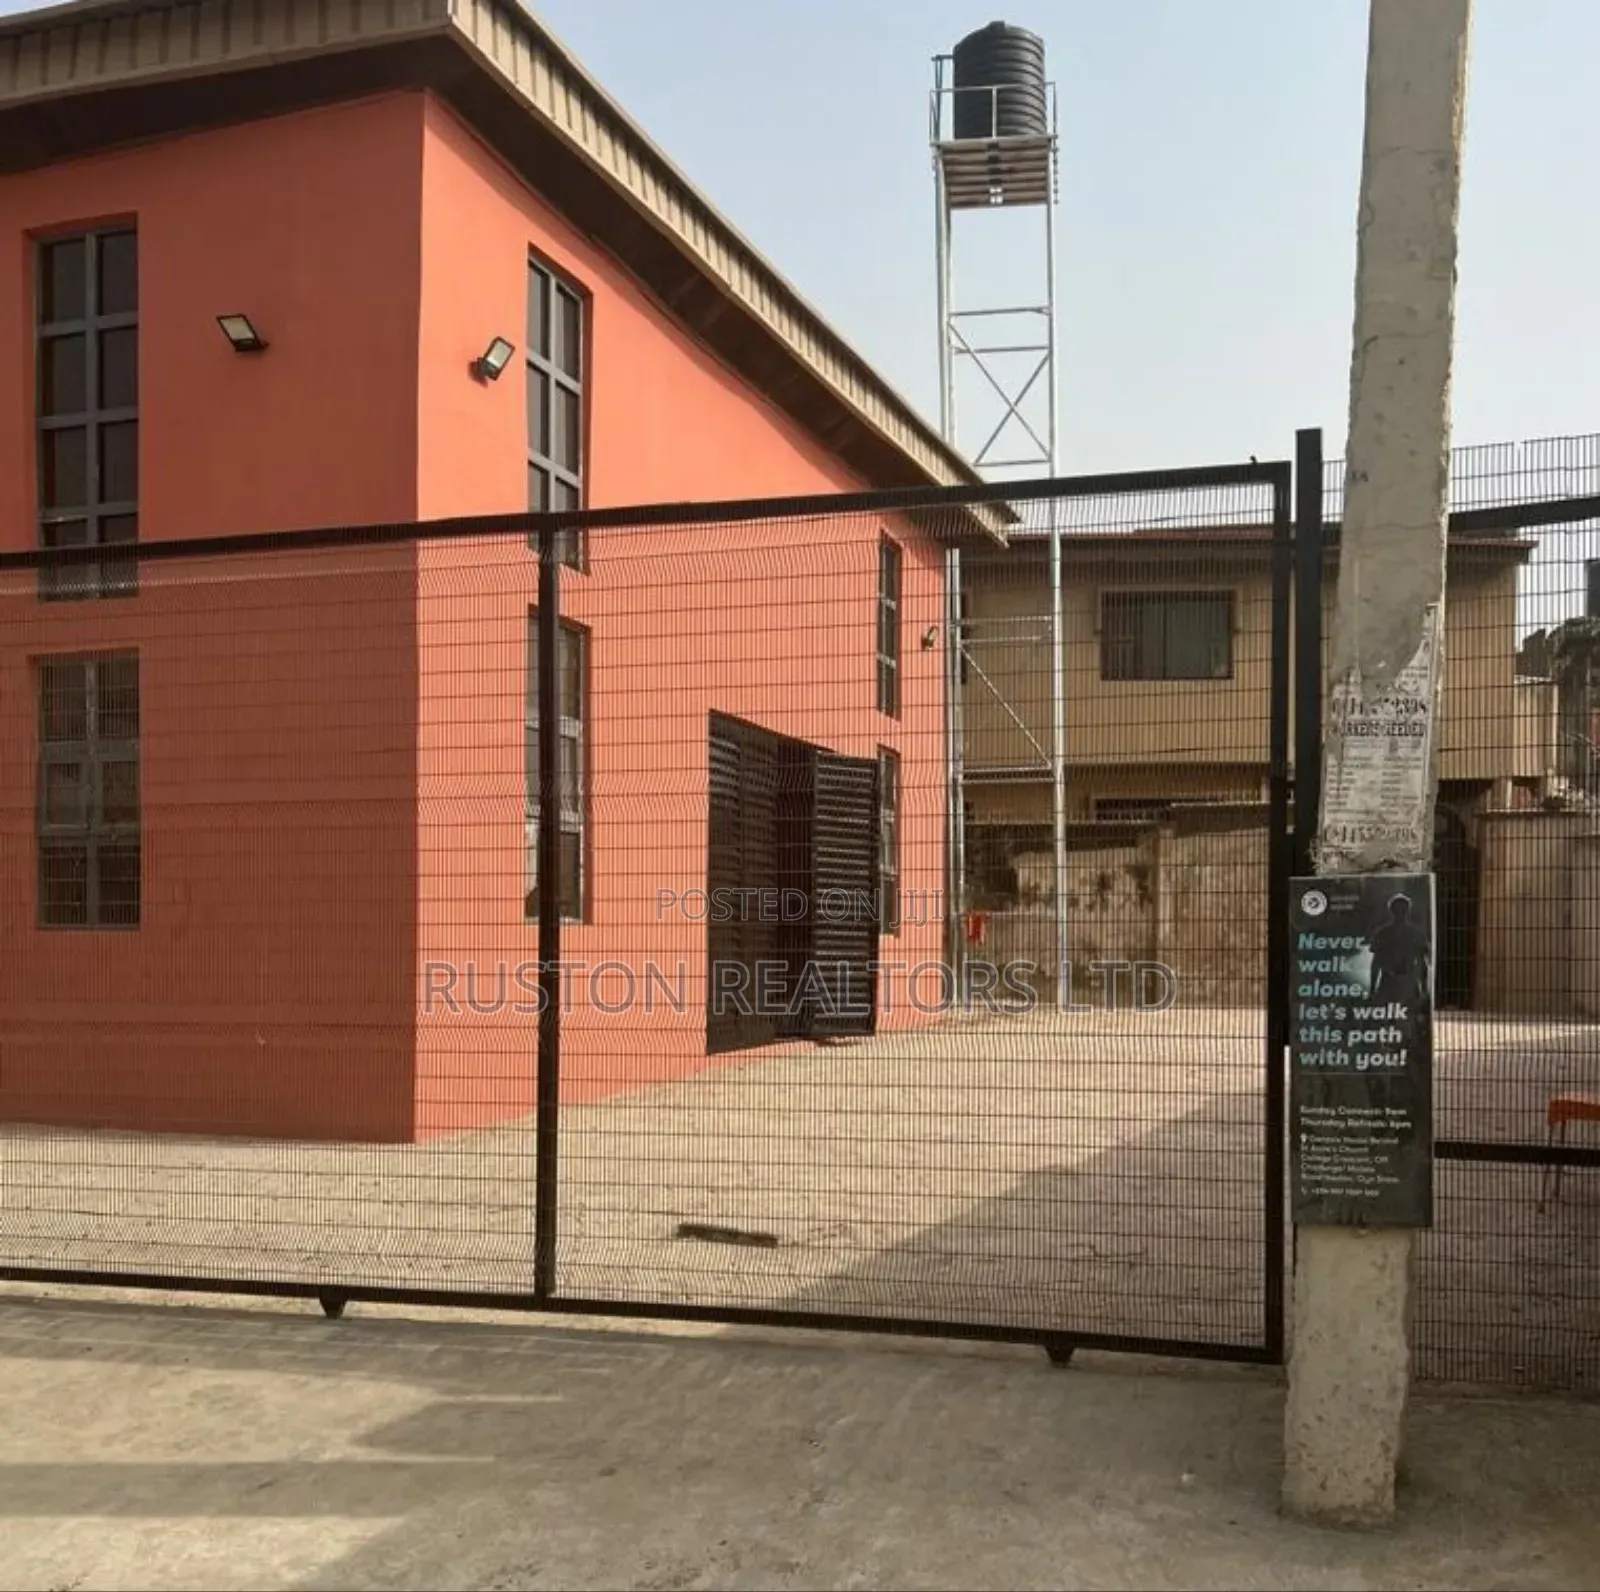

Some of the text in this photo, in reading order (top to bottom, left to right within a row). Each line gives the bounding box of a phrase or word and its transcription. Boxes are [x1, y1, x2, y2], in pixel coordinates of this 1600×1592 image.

[1298, 955, 1351, 973] walk
[1298, 979, 1370, 1000] alone,
[1300, 1002, 1408, 1021] let's walk
[1299, 1025, 1402, 1047] this path
[1299, 1048, 1408, 1071] with you!
